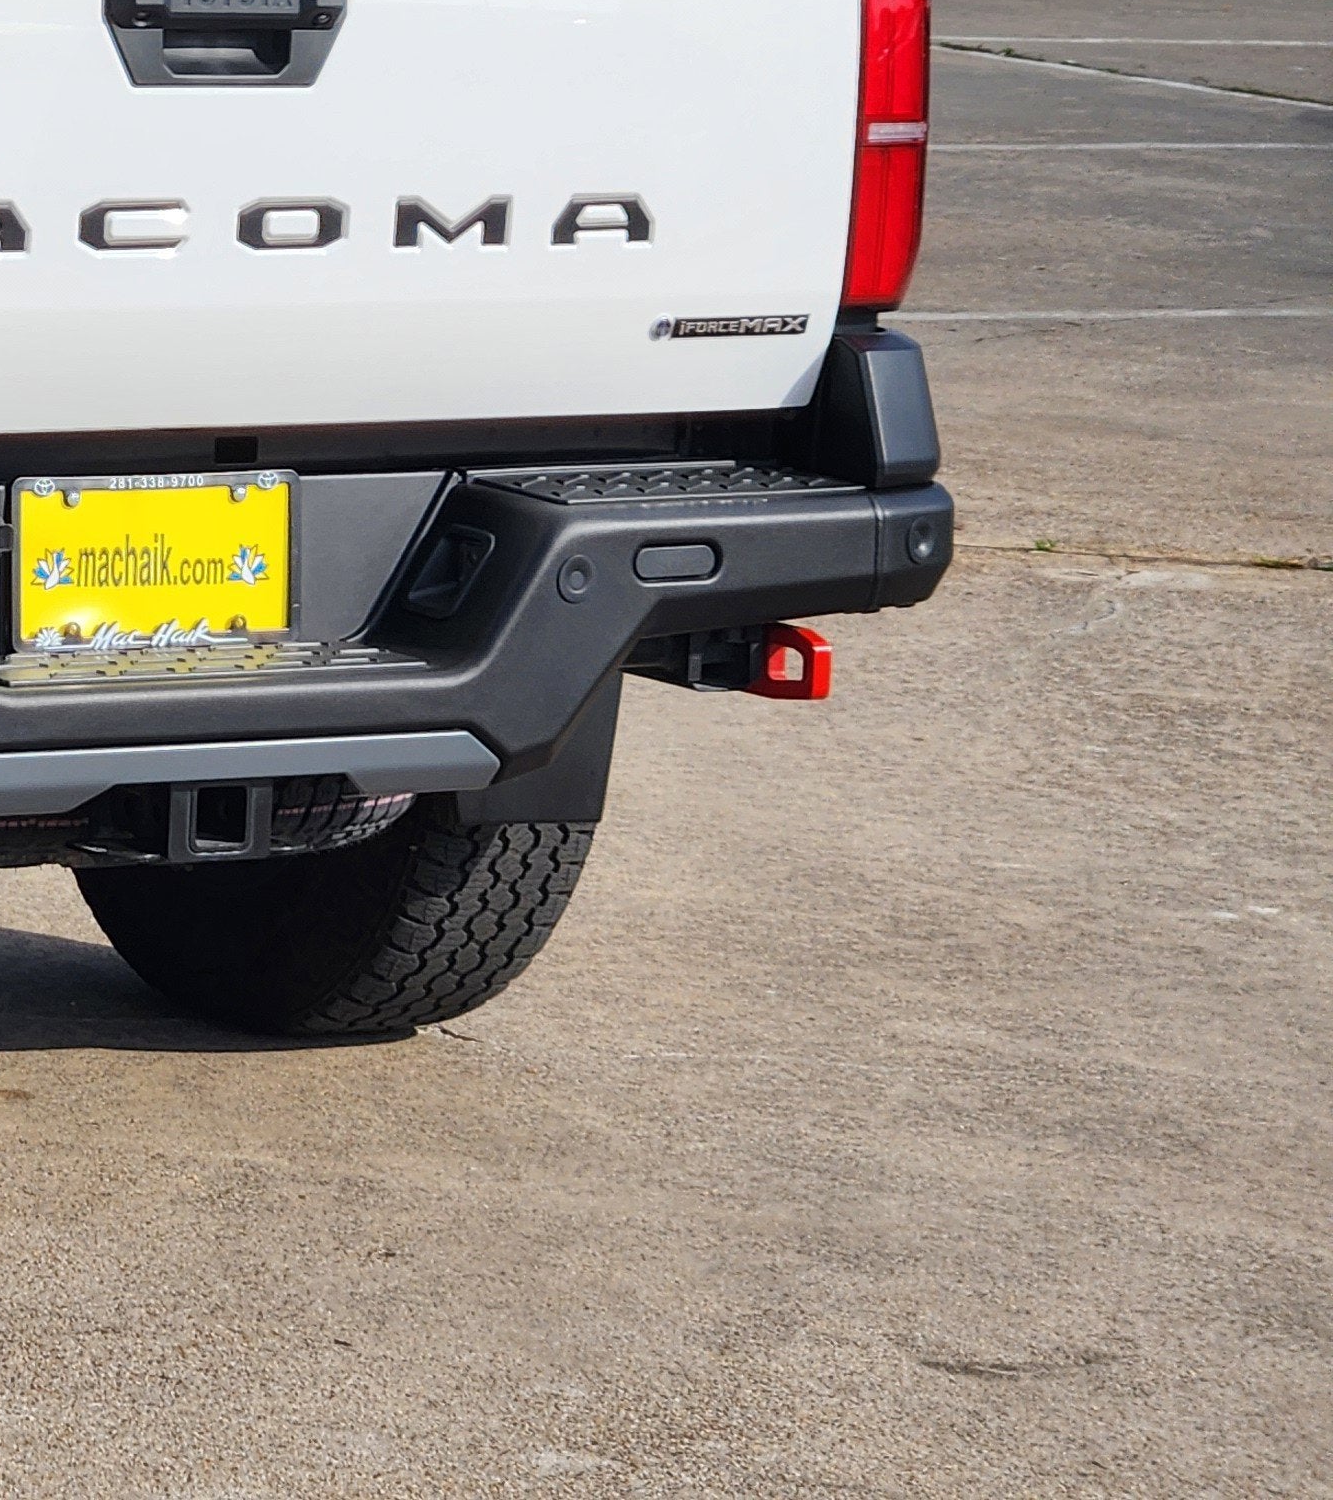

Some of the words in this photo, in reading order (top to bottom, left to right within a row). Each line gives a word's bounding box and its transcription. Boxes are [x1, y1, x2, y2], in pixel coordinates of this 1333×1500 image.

[109, 476, 205, 490] 281-338-9700
[76, 533, 225, 588] machaik.com
[89, 621, 151, 649] Mac
[151, 618, 248, 647] Haik
